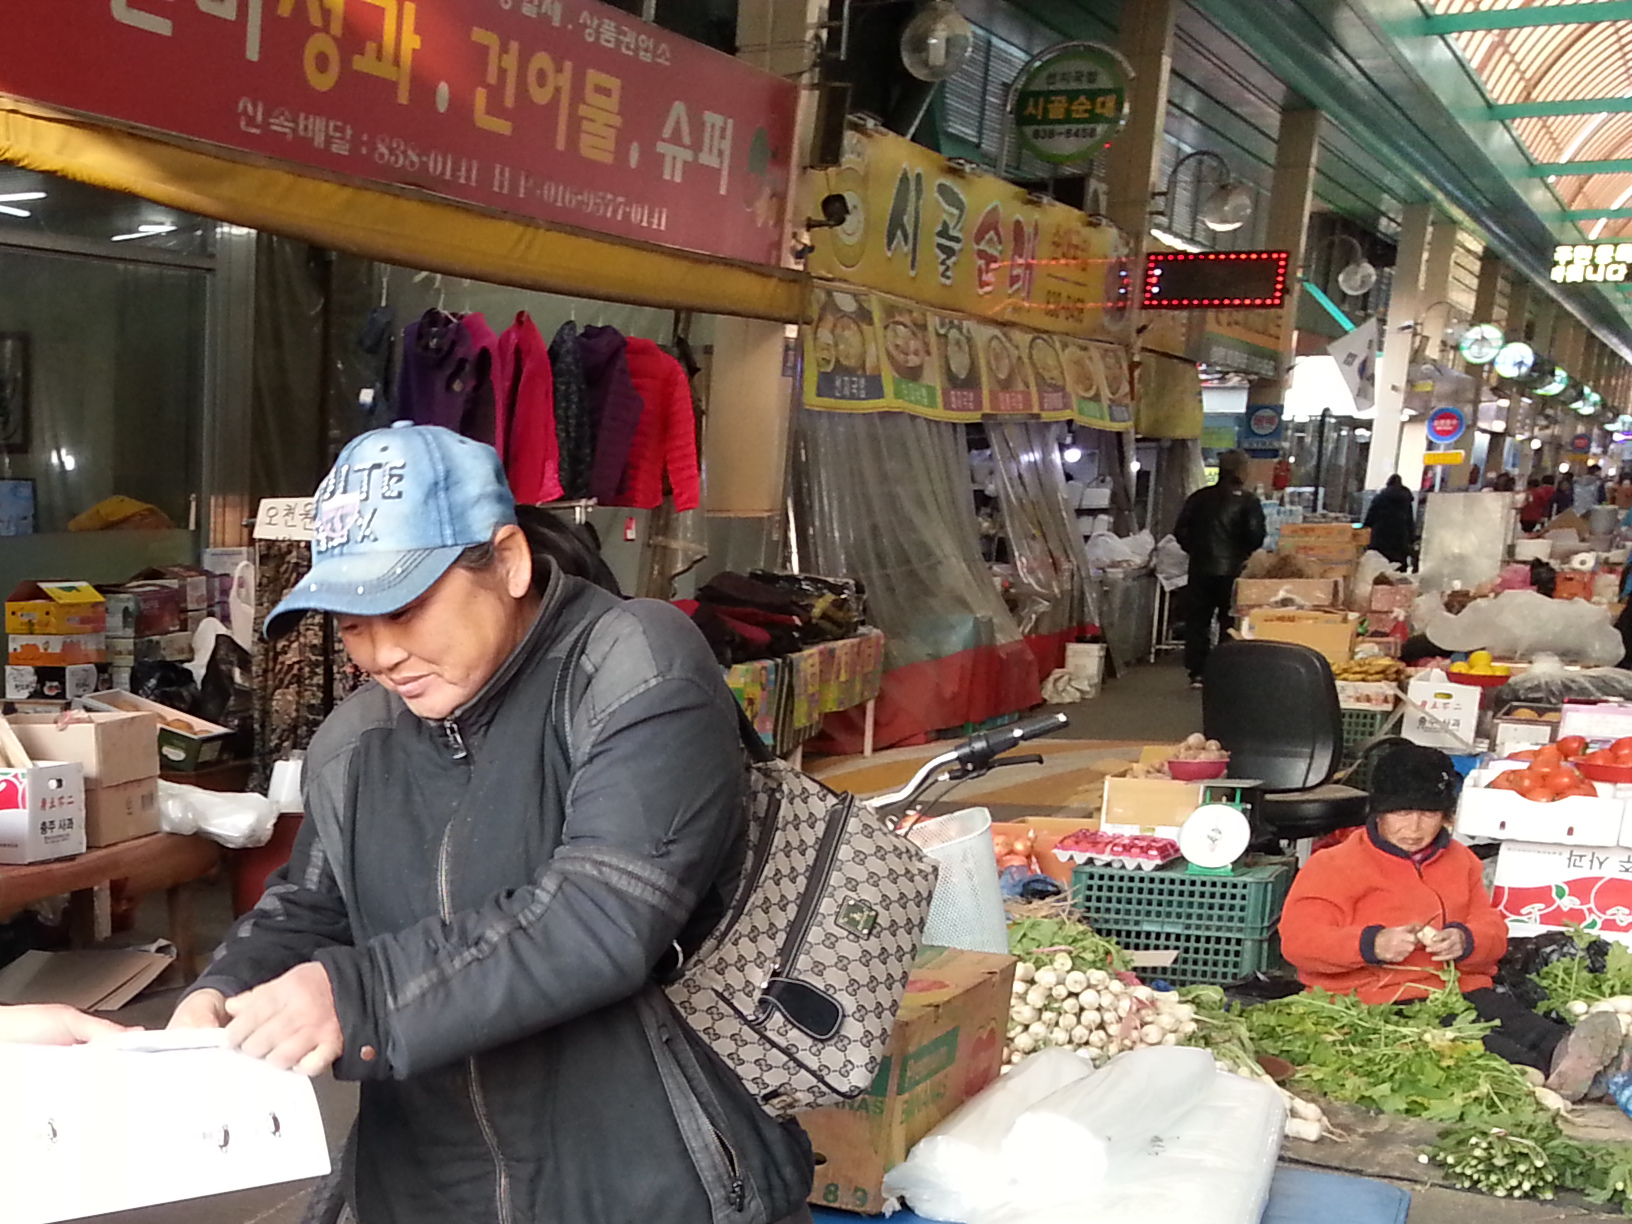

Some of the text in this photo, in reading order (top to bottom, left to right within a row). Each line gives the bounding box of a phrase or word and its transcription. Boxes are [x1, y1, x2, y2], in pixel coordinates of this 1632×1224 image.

[1024, 94, 1117, 119] 시골순대
[374, 133, 479, 187] 838-0141
[656, 100, 733, 196] 슈퍼
[885, 161, 1041, 301] 시골순대
